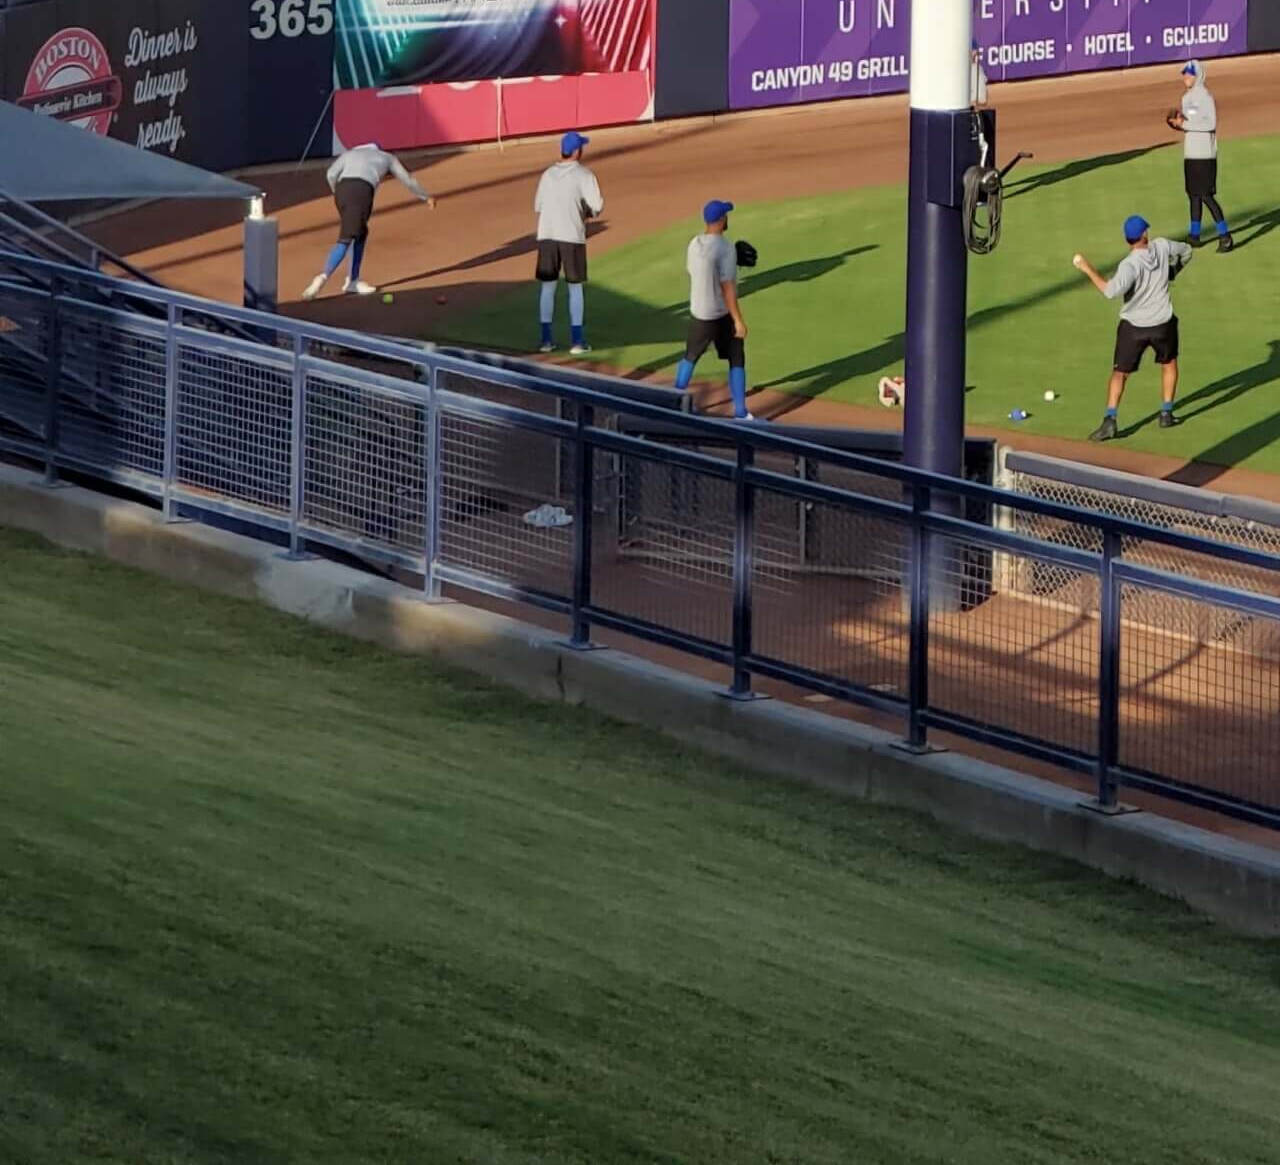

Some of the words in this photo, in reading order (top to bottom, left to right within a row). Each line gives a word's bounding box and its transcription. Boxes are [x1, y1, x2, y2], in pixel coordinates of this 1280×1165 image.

[35, 36, 100, 85] BOSTON
[124, 27, 182, 68] Dinner
[183, 20, 197, 51] is
[987, 39, 1055, 66] COURSE
[1084, 32, 1134, 56] HOTEL
[1162, 23, 1229, 48] GCU.EDU
[133, 68, 189, 107] always
[751, 64, 825, 92] CANYON
[828, 61, 852, 82] 49
[857, 55, 909, 80] GRILL
